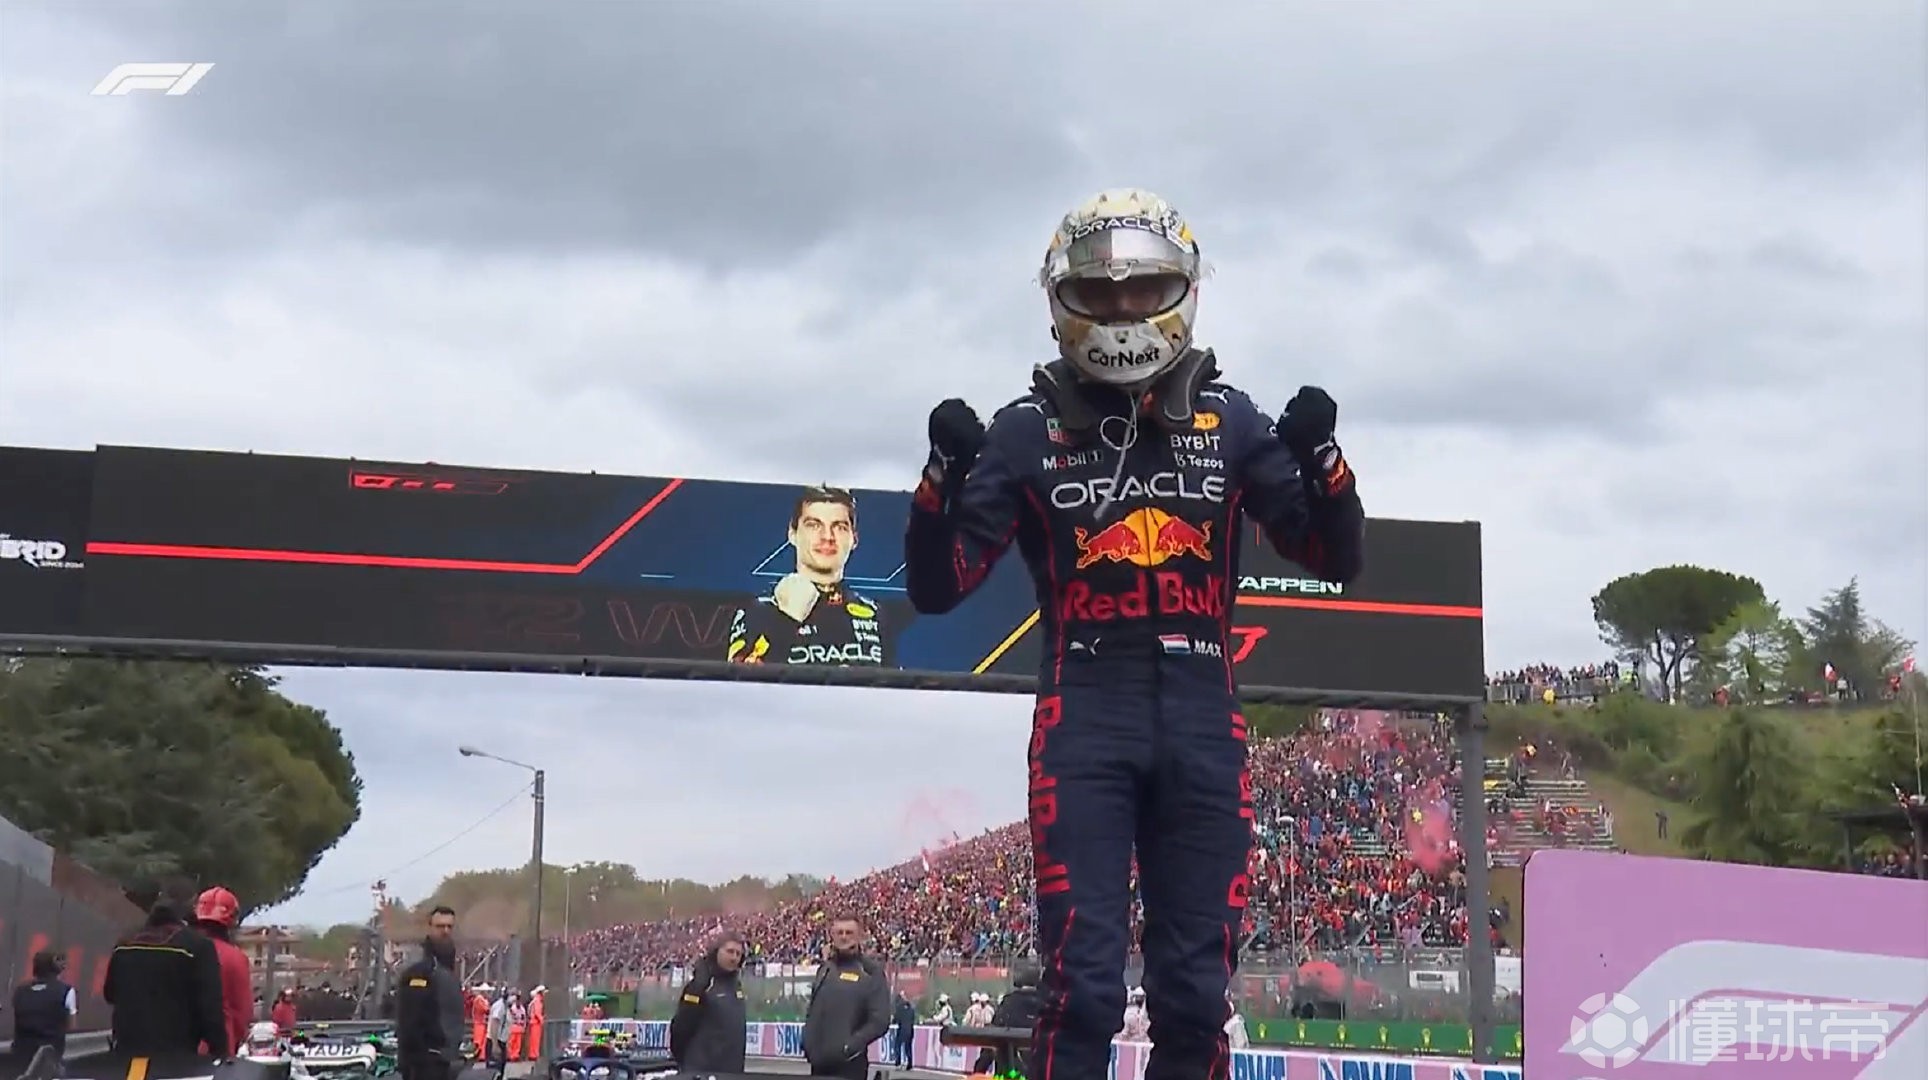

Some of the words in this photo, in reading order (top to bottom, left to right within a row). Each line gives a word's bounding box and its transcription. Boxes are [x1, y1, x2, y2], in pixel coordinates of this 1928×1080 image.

[1087, 347, 1160, 367] CarNext
[1170, 431, 1221, 451] BYBIT
[1042, 451, 1087, 470] Mobil
[1187, 454, 1224, 469] Tezos
[1051, 472, 1225, 509] ORACLE
[1063, 570, 1149, 621] Red
[1237, 577, 1343, 594] APPEN
[1194, 638, 1222, 658] MAX
